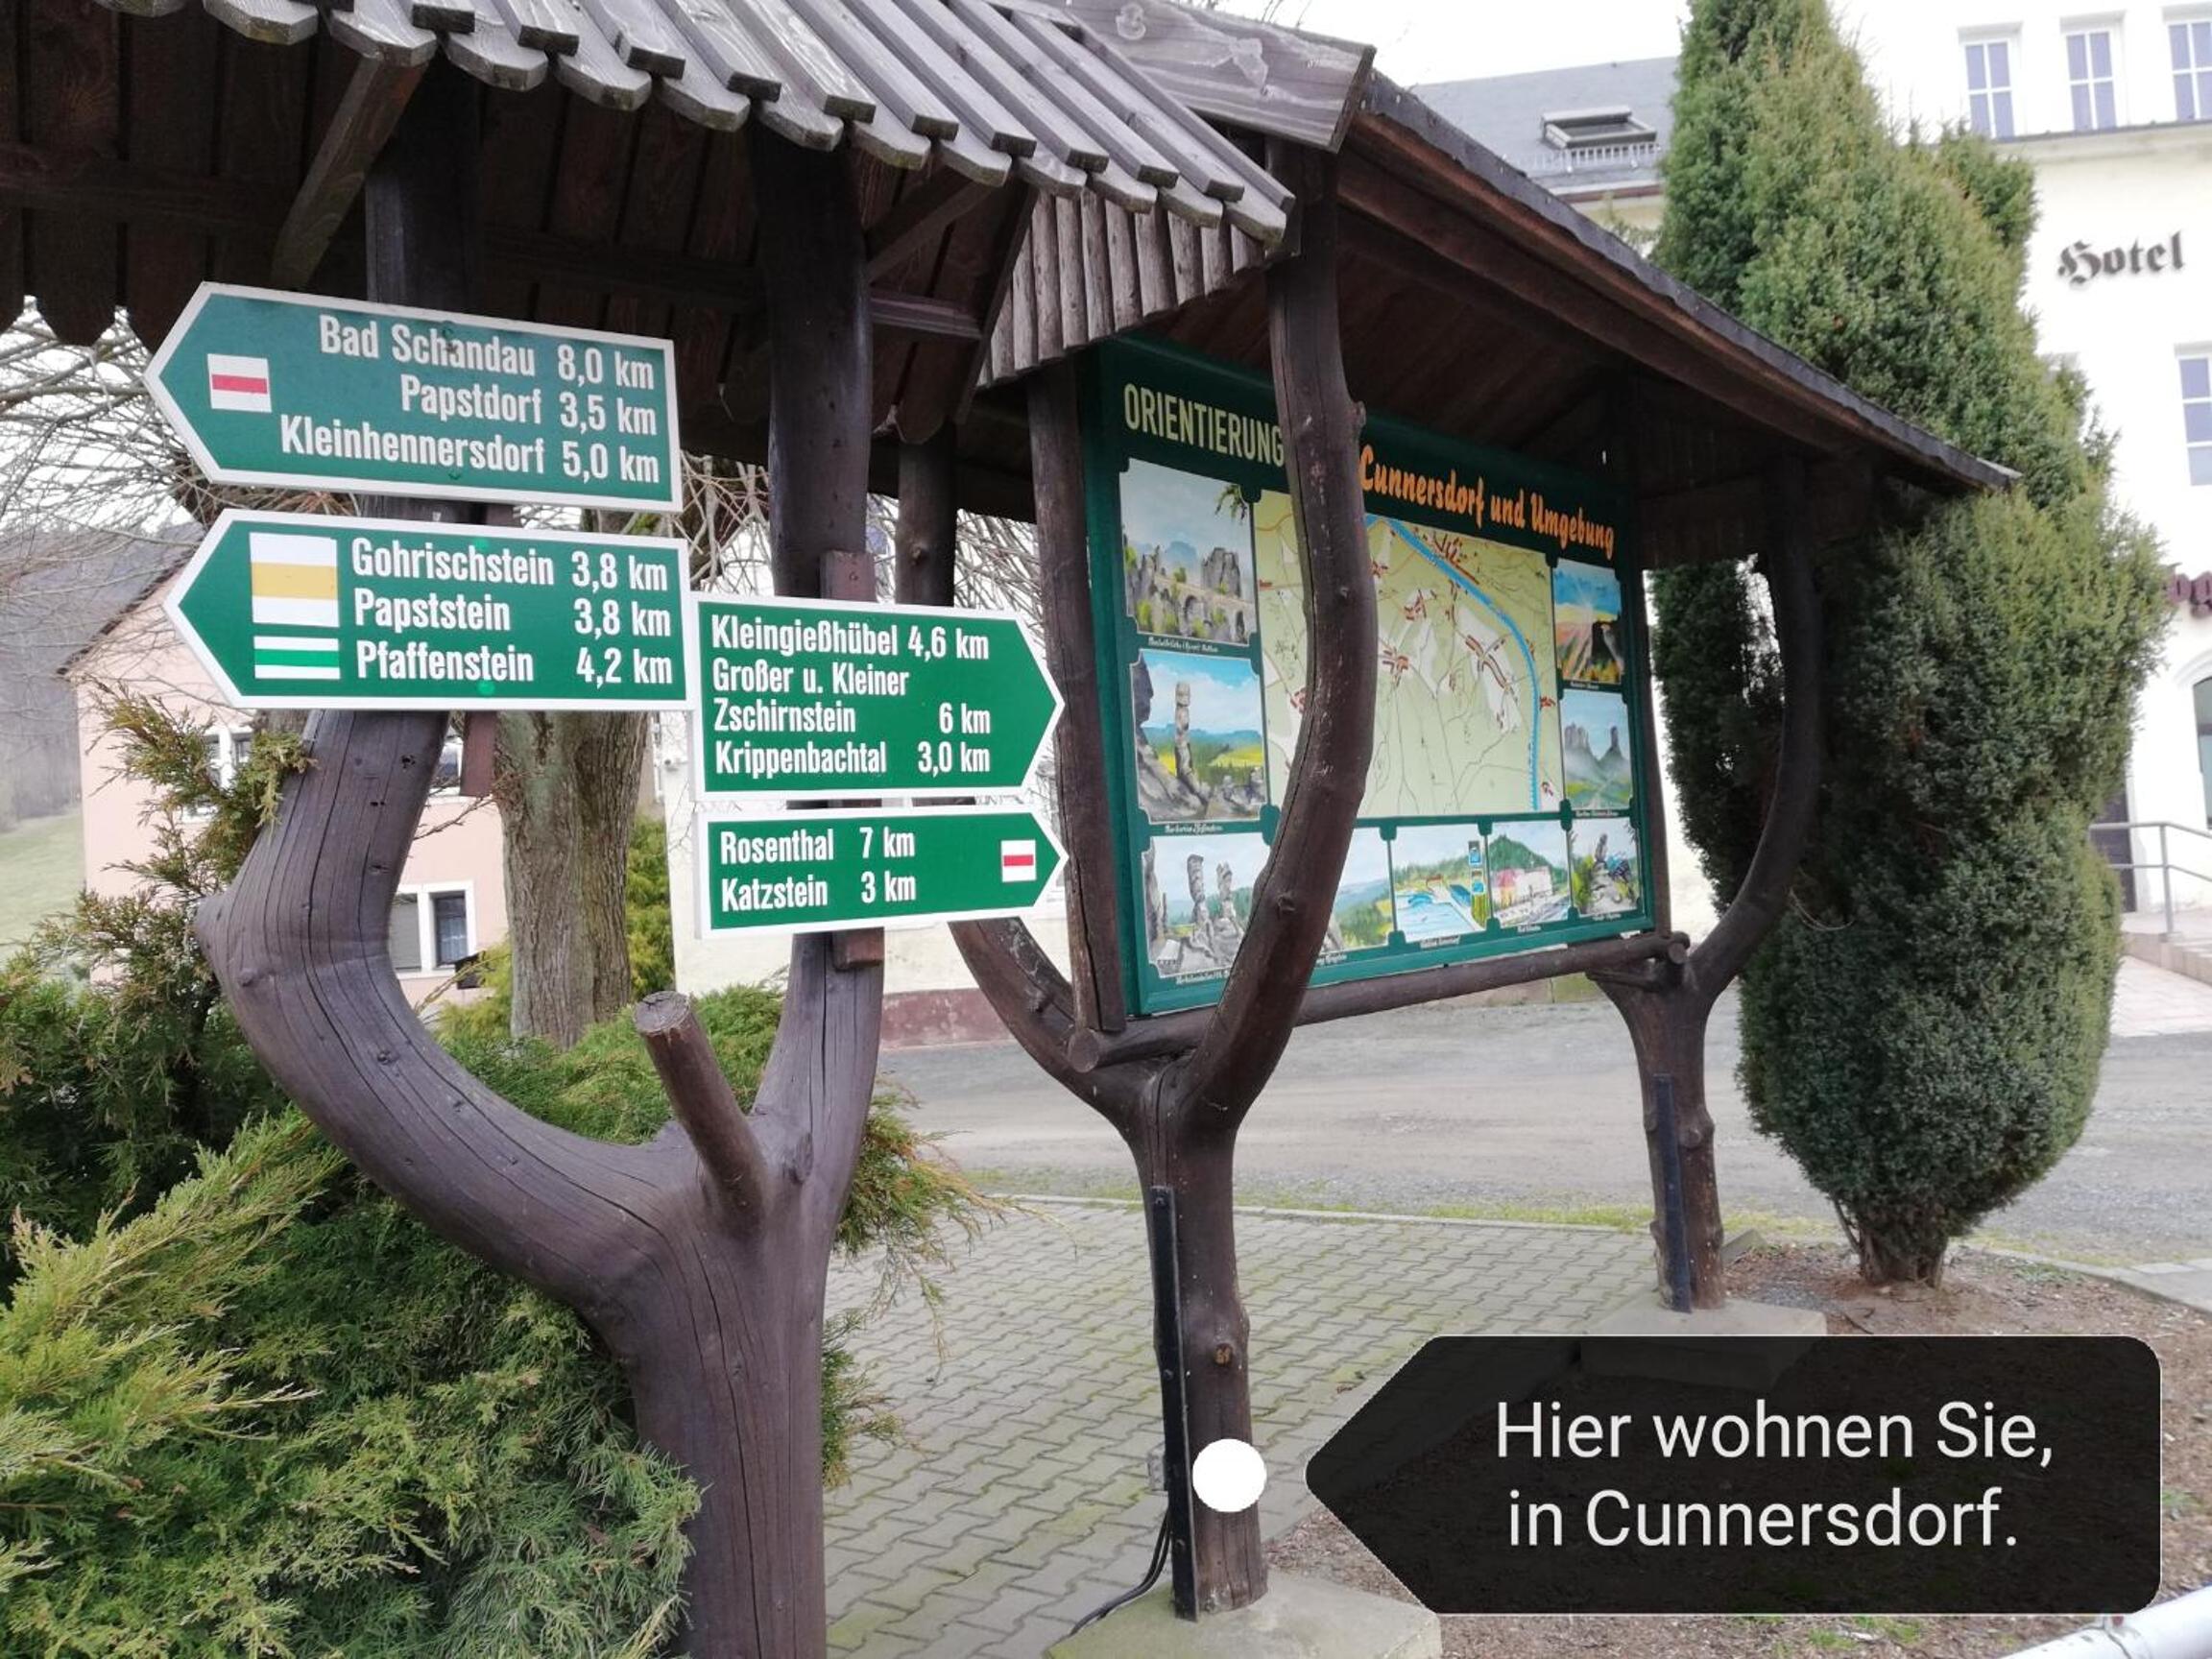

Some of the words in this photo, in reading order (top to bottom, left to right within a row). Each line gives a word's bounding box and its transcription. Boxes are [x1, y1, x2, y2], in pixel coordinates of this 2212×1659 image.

[2056, 230, 2185, 289] Hotel
[319, 314, 379, 359] Bad
[391, 324, 536, 376] Schandau
[557, 344, 604, 387] 8,0
[614, 351, 655, 390] km
[400, 373, 542, 424] Papstdorf
[559, 391, 607, 435] 3,5
[616, 397, 658, 436] km
[279, 414, 545, 474] Kleinhennersdorf
[562, 440, 609, 483] 5,0
[619, 445, 660, 483] km
[1358, 444, 1484, 529] Cunnersdorf
[1490, 488, 1526, 529] und
[1530, 491, 1616, 561] Umgebung
[351, 537, 555, 586] Gohrischstein
[571, 550, 618, 593] 3,8
[628, 554, 668, 591] km
[354, 587, 511, 635] Papststein
[573, 597, 621, 640] 3,8
[631, 600, 671, 637] km
[710, 613, 899, 657] Kleingießhübel
[907, 625, 947, 661] 4,6
[955, 628, 990, 661] km
[356, 639, 534, 682] Pfaffenstein
[576, 647, 622, 688] 4,2
[633, 648, 673, 685] km
[712, 657, 794, 694] Großer
[802, 668, 824, 695] u.
[831, 661, 910, 696] Kleiner
[713, 697, 856, 733] Zschirnstein
[938, 702, 953, 734] 6
[960, 703, 991, 734] km
[715, 739, 887, 780] Krippenbachtal
[918, 741, 953, 778] 3,0
[960, 741, 991, 773] km
[720, 828, 834, 865] Rosenthal
[859, 827, 874, 858] 7
[883, 826, 916, 857] km
[721, 873, 829, 912] Katzstein
[860, 871, 877, 903] 3
[884, 870, 917, 902] km
